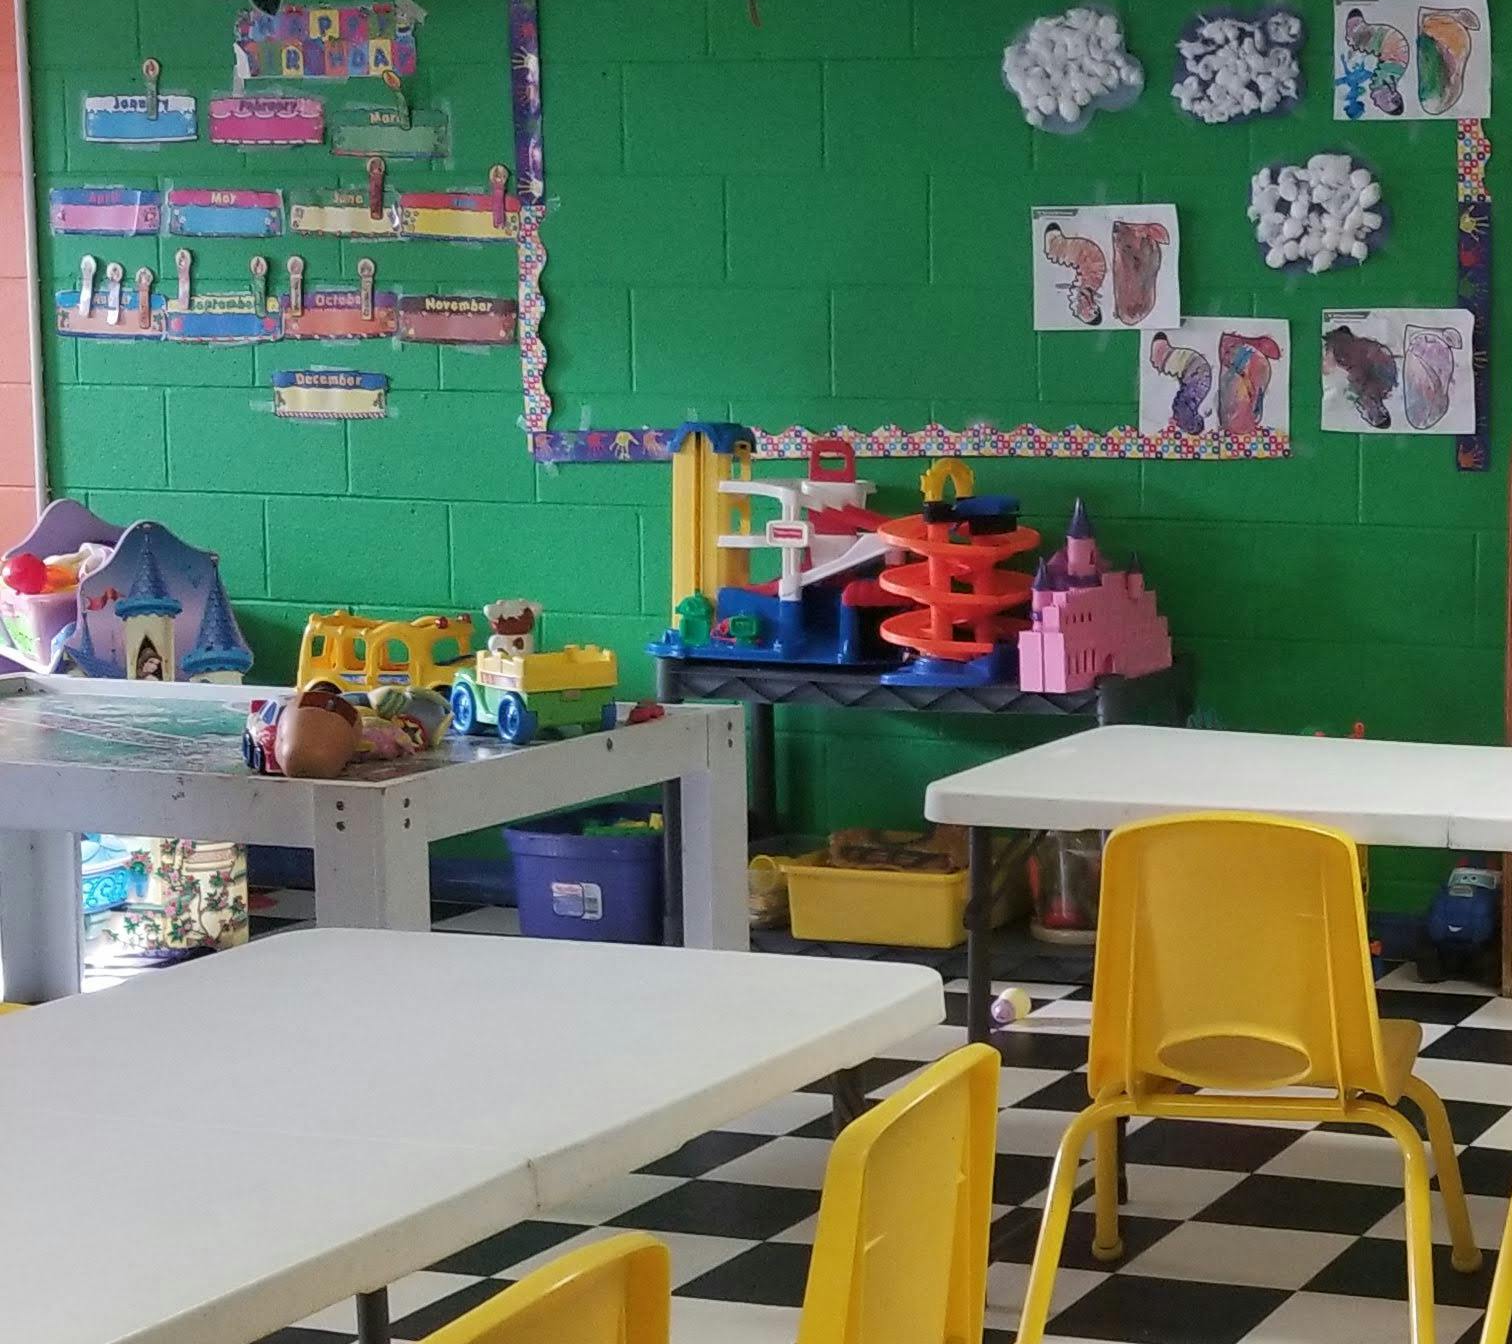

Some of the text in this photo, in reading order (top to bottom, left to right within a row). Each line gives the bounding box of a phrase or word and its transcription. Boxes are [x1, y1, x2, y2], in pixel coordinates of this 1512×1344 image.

[113, 96, 169, 112] Januy
[211, 191, 236, 205] May
[315, 293, 361, 306] Octobe
[425, 297, 493, 312] November
[295, 373, 362, 386] December
